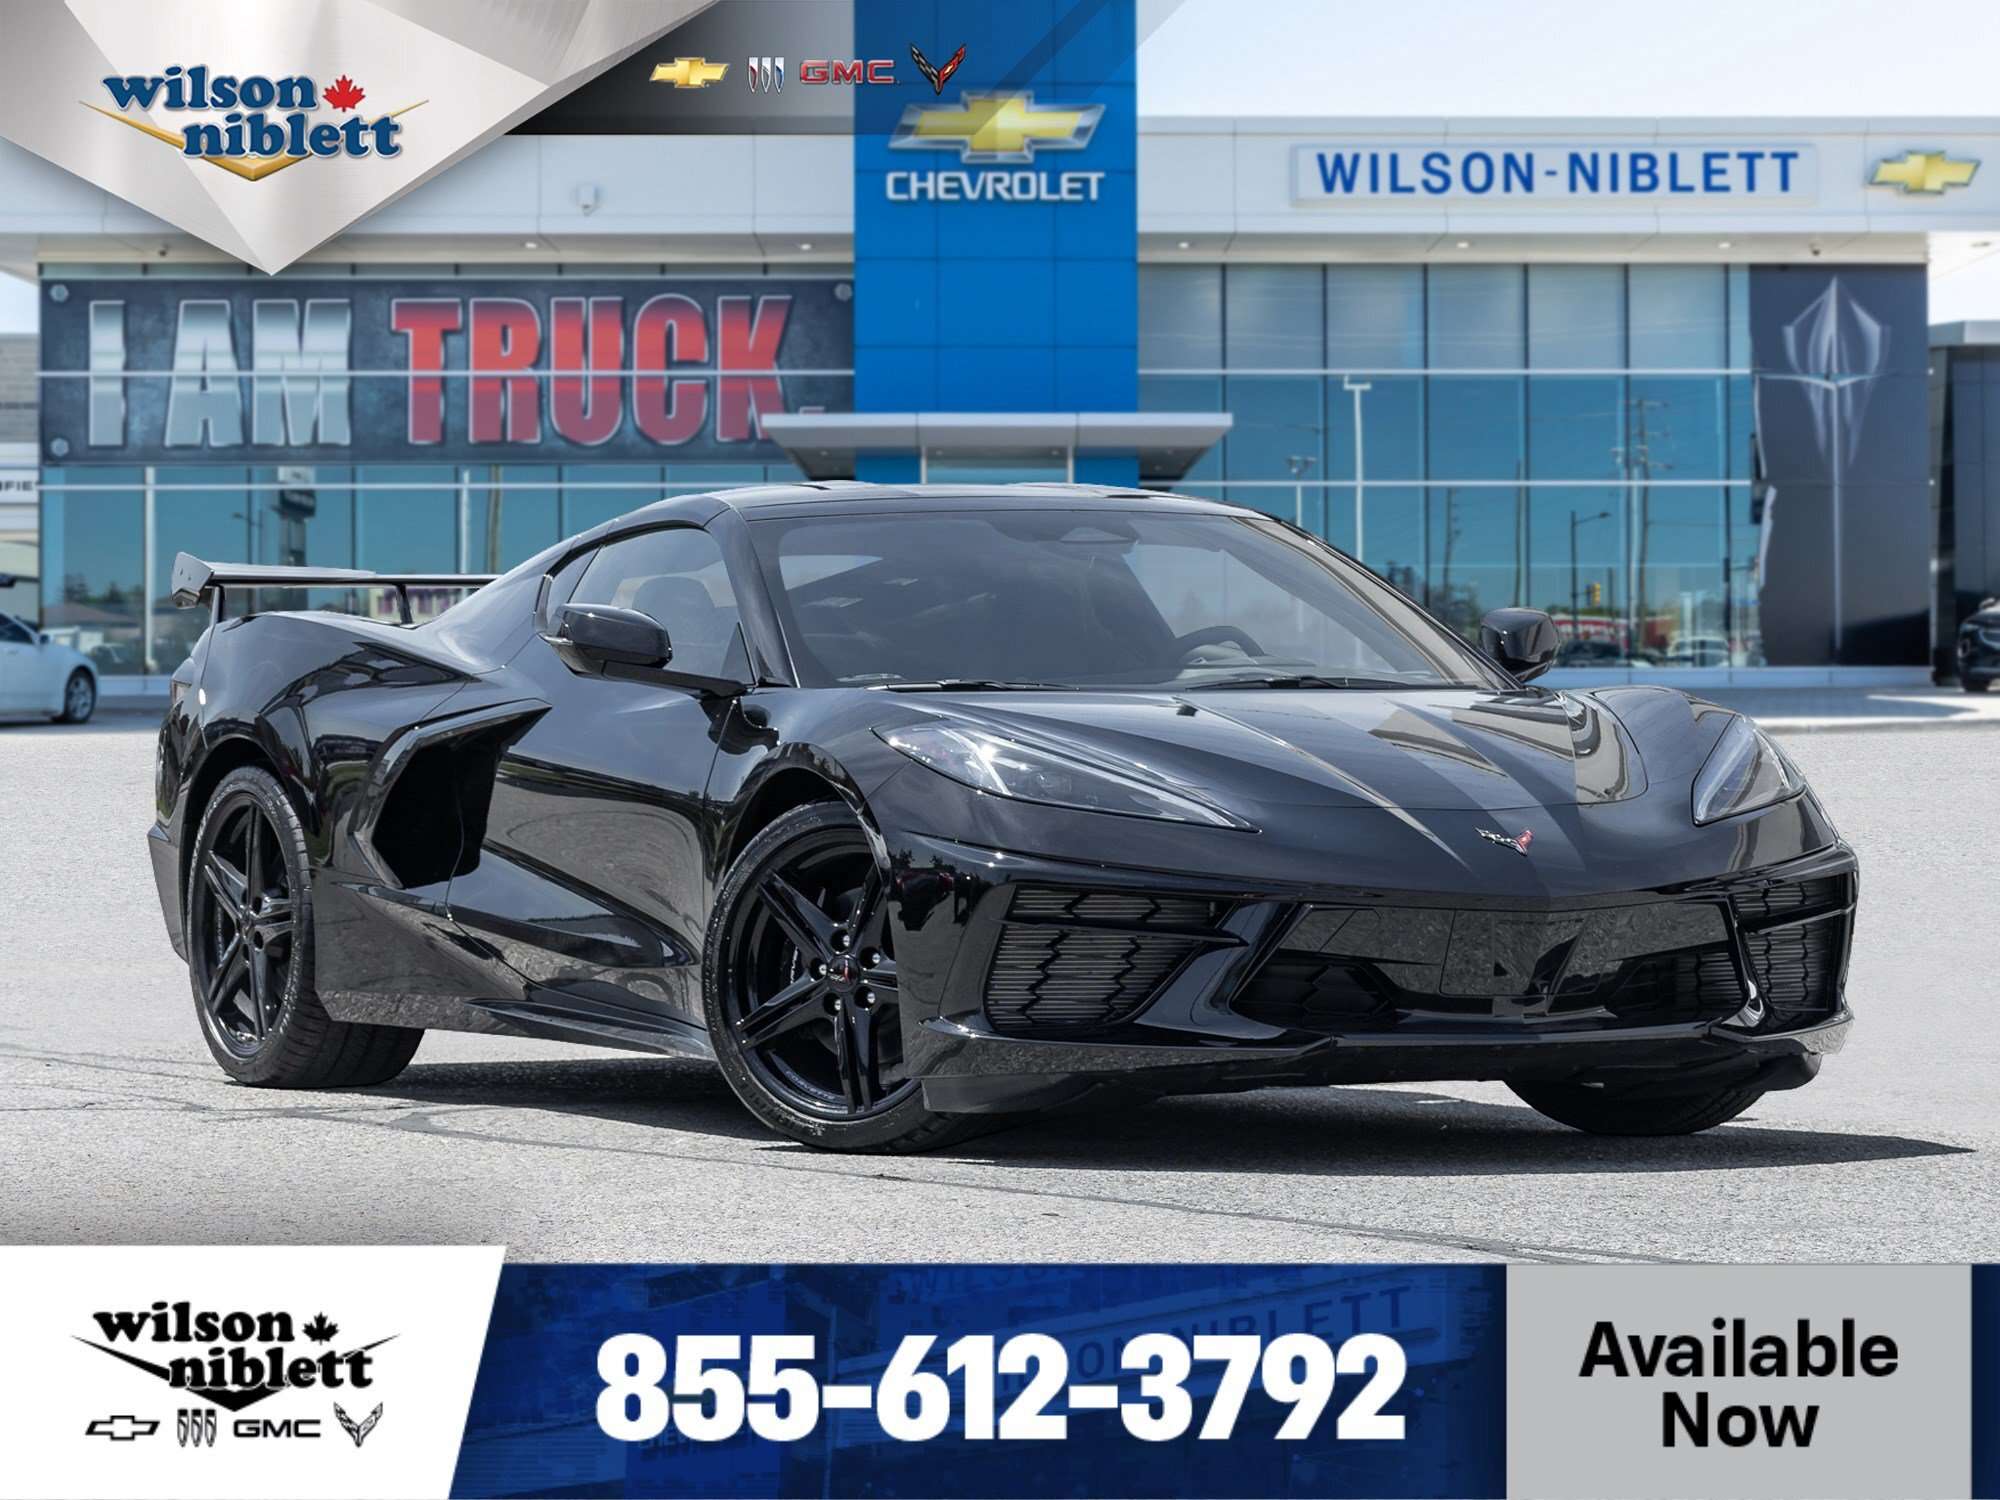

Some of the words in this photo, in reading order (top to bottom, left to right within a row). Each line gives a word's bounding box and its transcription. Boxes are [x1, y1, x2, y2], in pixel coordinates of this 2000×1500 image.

[886, 171, 1105, 201] CHEVROLET
[1315, 151, 1798, 195] WILSON-NIBLETT
[88, 299, 127, 447] I
[164, 298, 352, 448] AM
